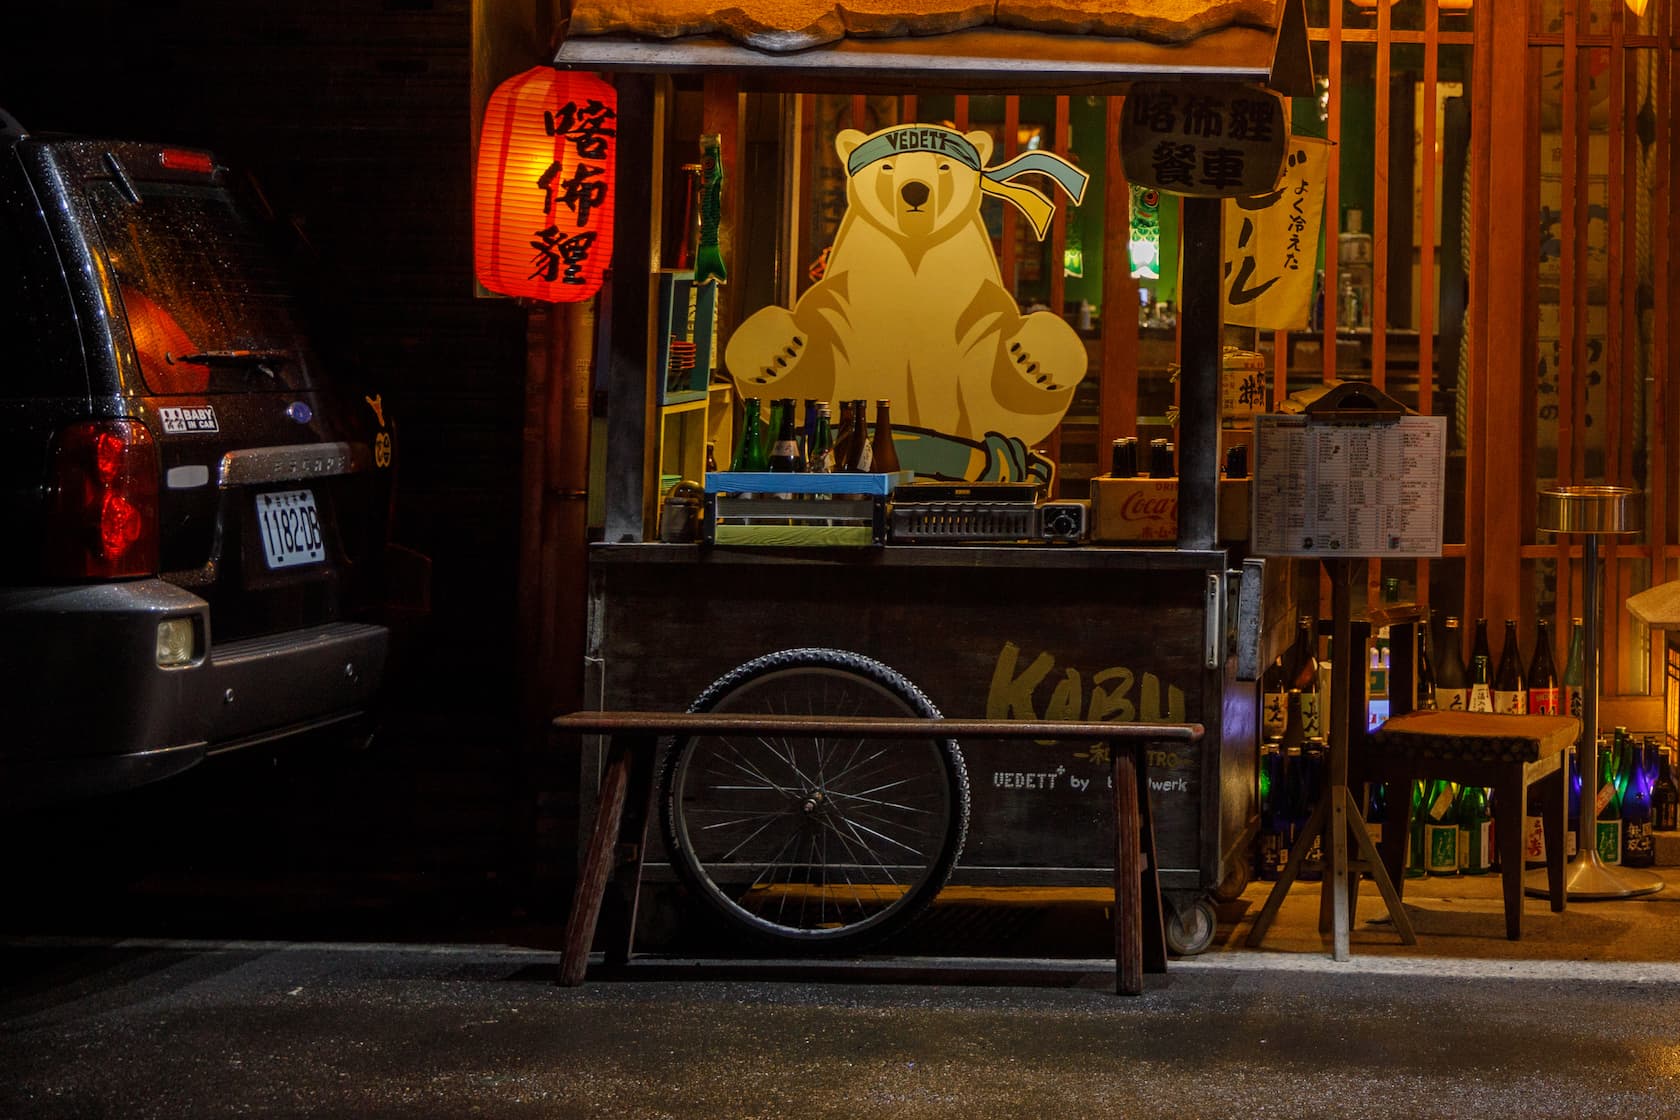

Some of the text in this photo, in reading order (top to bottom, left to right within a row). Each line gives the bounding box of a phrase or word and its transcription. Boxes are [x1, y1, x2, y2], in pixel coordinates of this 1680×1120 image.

[885, 129, 946, 151] VEDETT
[1152, 141, 1245, 190] 餐車
[1284, 179, 1310, 270] よく冷えた
[183, 408, 214, 421] BABY
[1069, 776, 1090, 792] by
